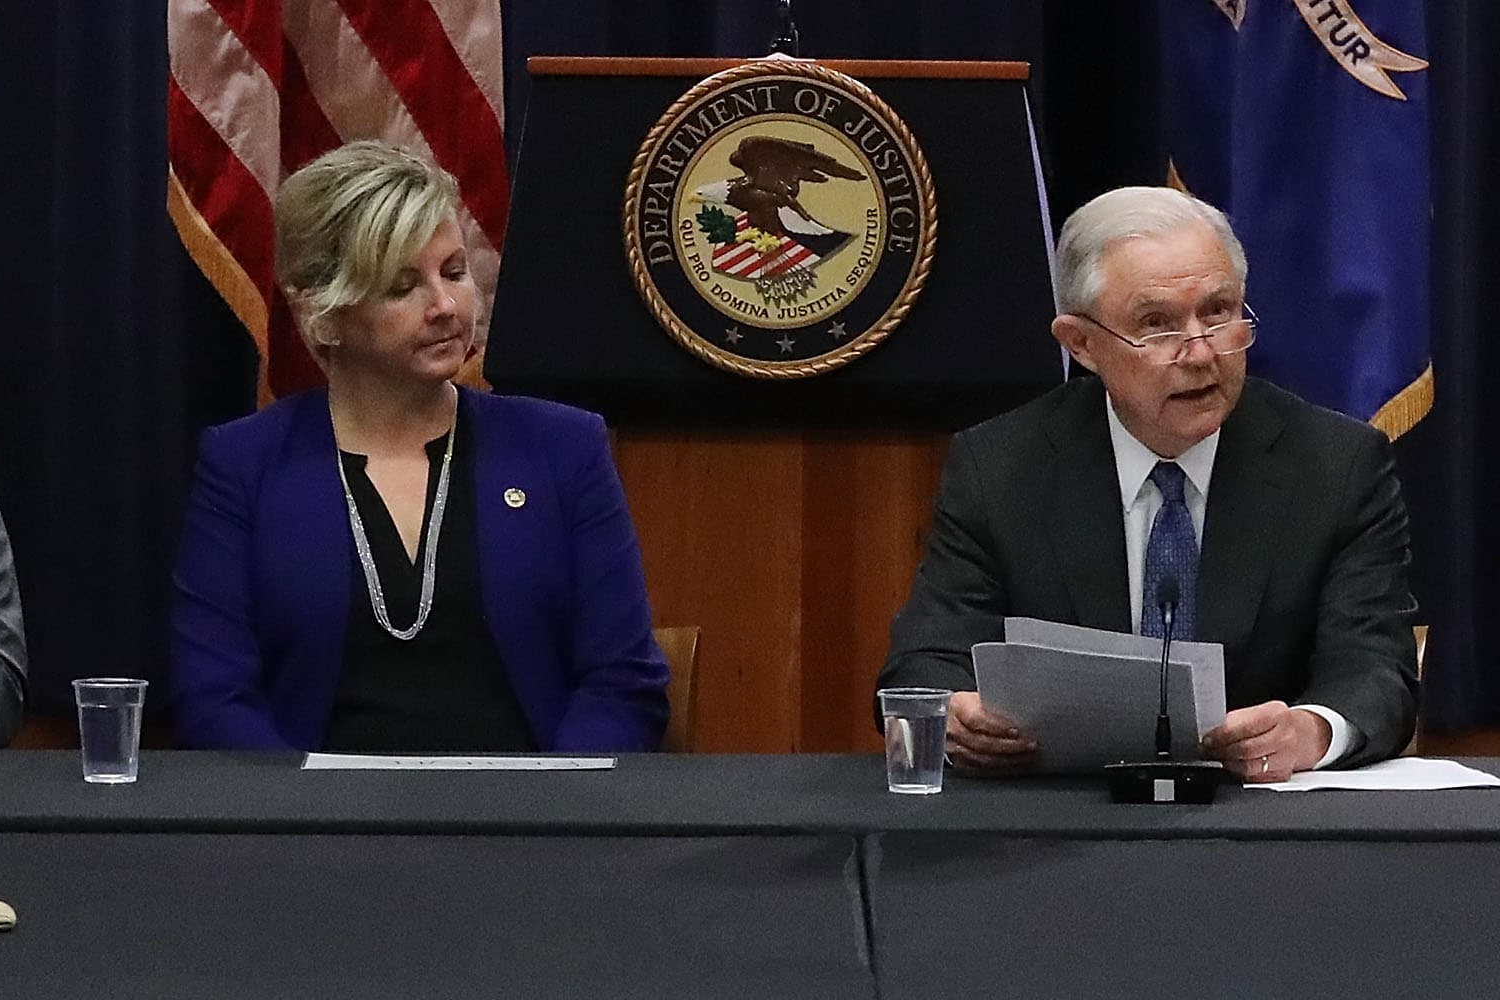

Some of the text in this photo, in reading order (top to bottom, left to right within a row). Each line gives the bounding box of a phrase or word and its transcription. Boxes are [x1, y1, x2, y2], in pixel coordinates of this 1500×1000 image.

[644, 85, 915, 265] DEPARTMENT OF JUSTICE
[680, 208, 878, 320] QUI PRO DOMINA JUSTITIA SEQUITUR
